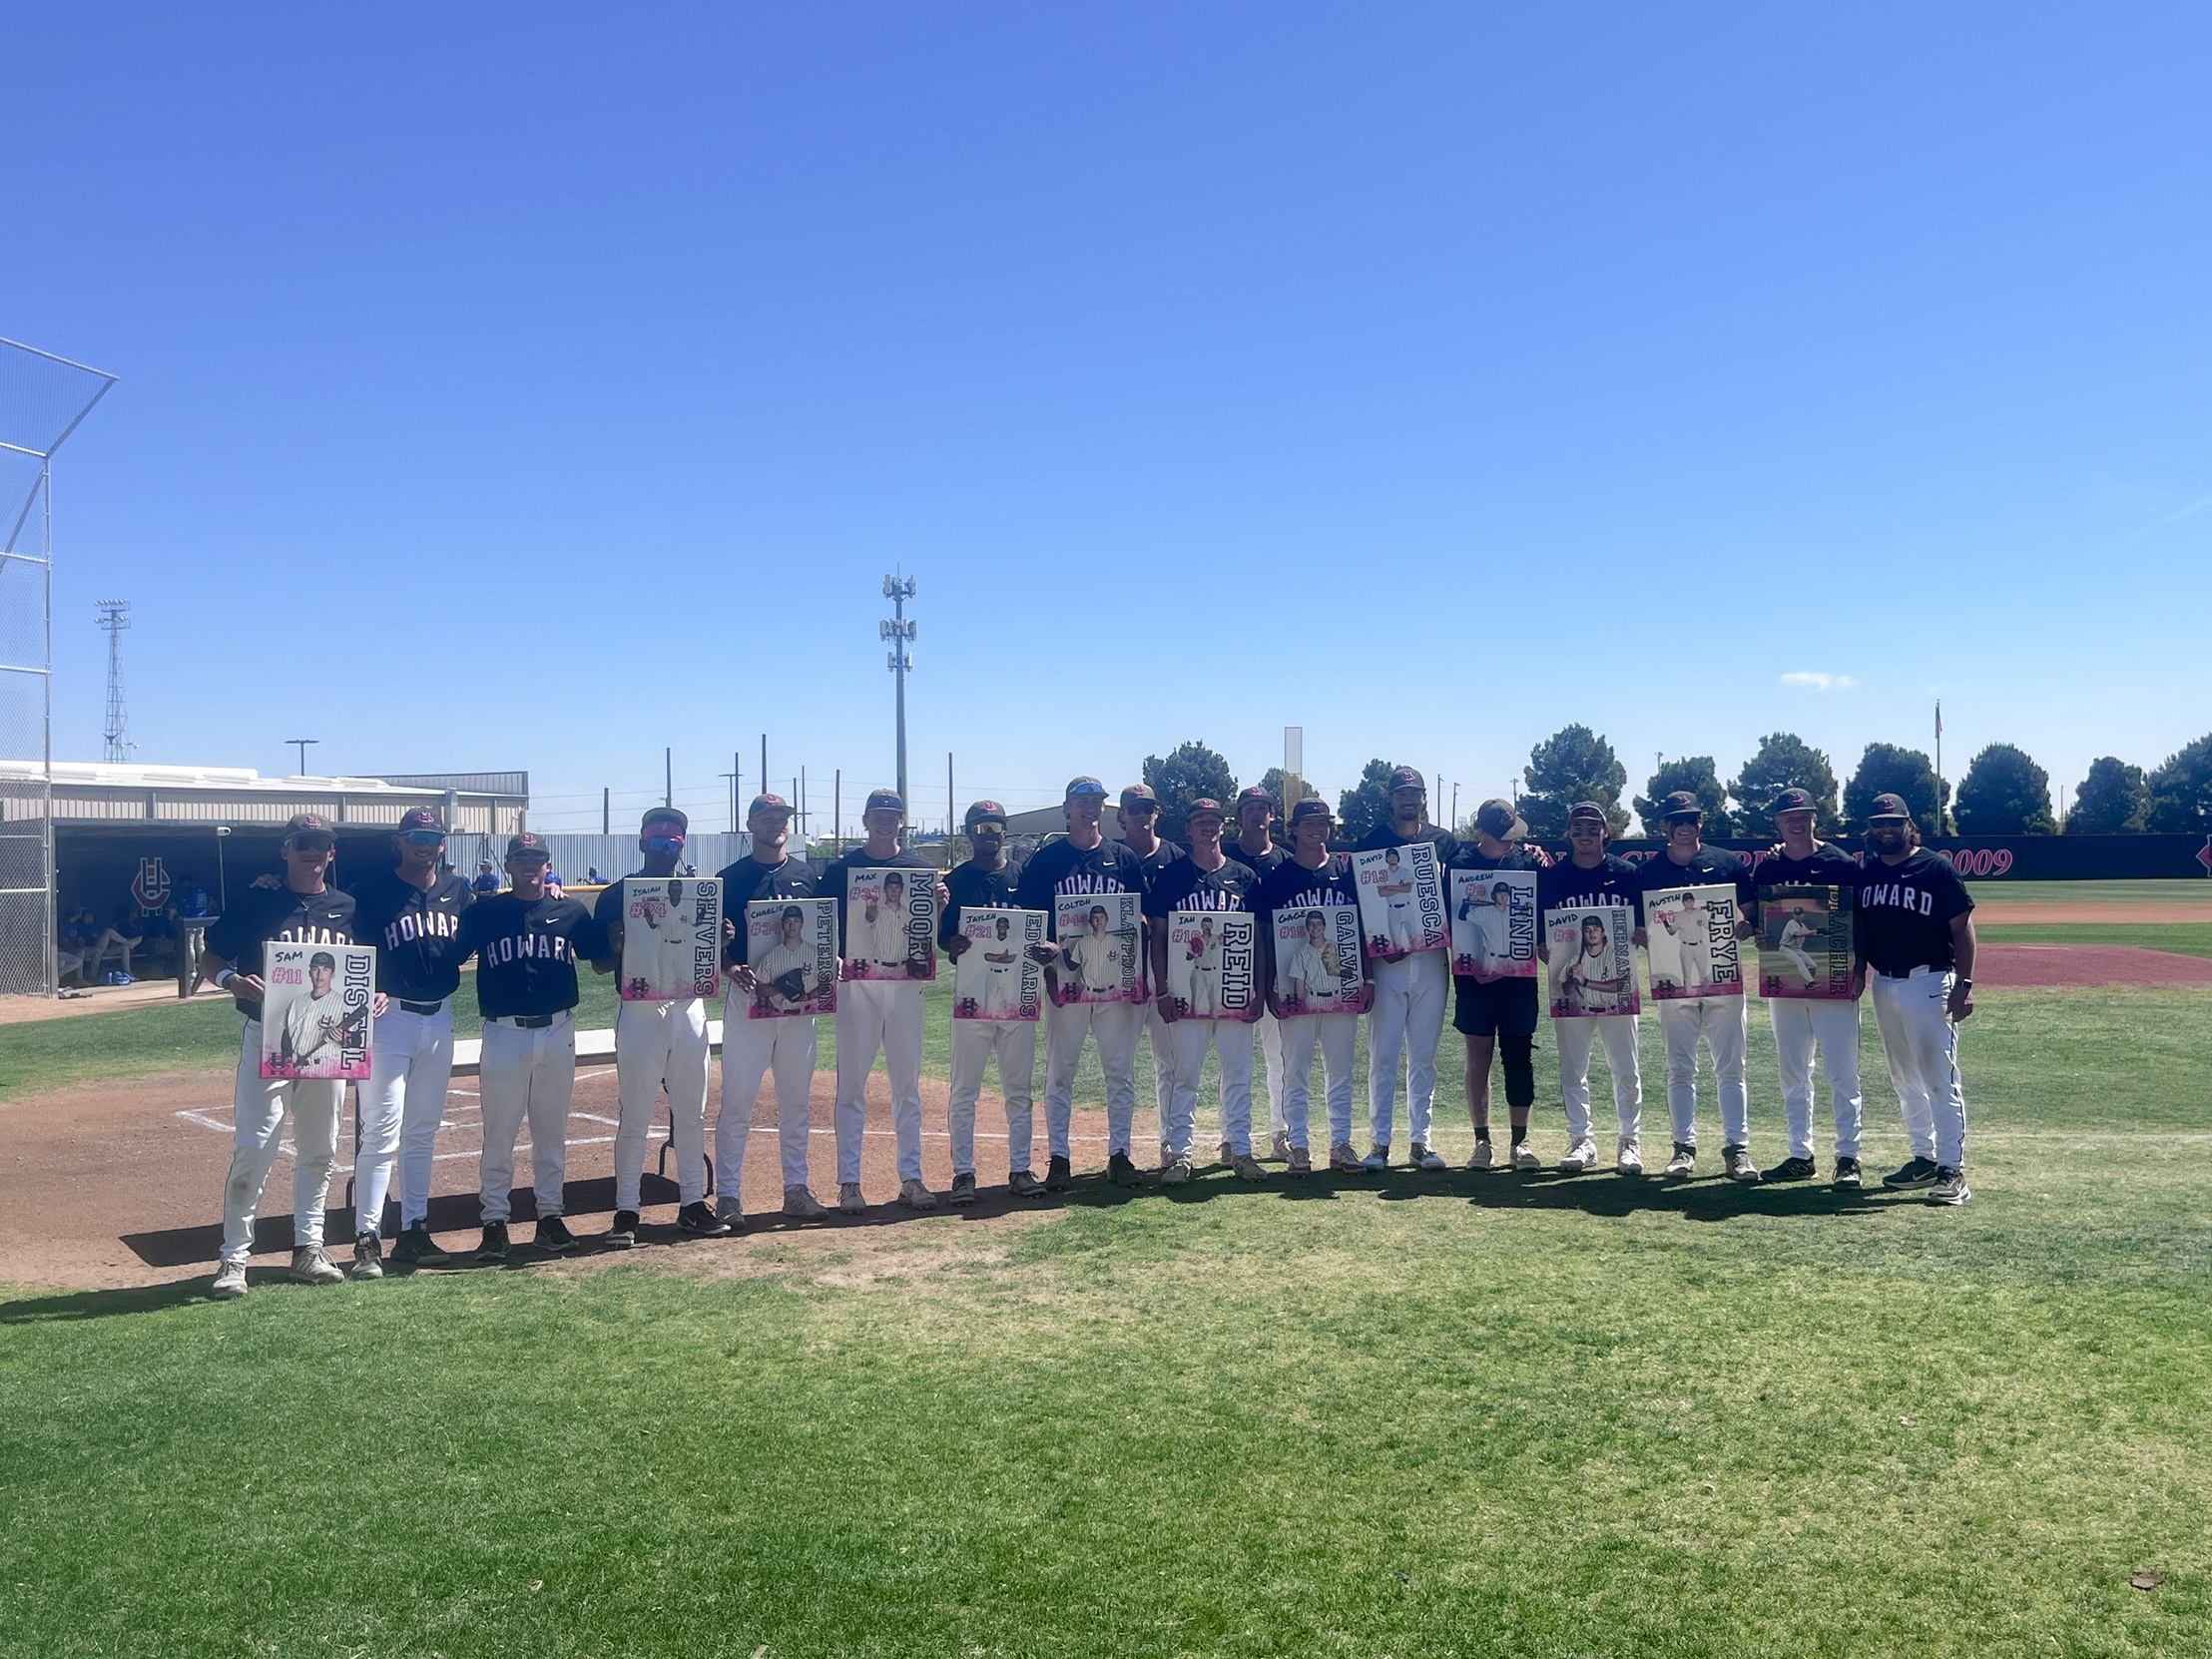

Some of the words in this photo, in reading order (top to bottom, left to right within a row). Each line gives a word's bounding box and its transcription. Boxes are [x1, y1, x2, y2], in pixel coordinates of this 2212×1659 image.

[1360, 853, 1383, 865] DAVID
[854, 873, 877, 883] MAX
[1360, 869, 1388, 884] #13
[1457, 873, 1493, 884] ANDREW
[1410, 845, 1444, 947] RUESCA
[1648, 893, 1681, 908] AUSTIN
[1861, 883, 1933, 916] OWARD
[750, 904, 785, 919] CHARLIE
[1058, 898, 1091, 911] COLTON
[965, 913, 997, 924] JAYLEN
[1178, 916, 1196, 925] IAN
[1278, 910, 1307, 924] GAGE
[1509, 885, 1533, 961] LIND
[1547, 914, 1578, 928] DAVID
[383, 911, 458, 951] HOWAR
[694, 881, 718, 996] SHIVERS
[964, 924, 992, 938] #21
[1120, 896, 1137, 997] KLAPPRODT
[1706, 898, 1740, 984] FRYE
[275, 951, 303, 963] SAM
[486, 933, 573, 968] HOWAR
[817, 901, 833, 1012] PETERSON
[1336, 910, 1360, 1003] GALVAN
[1221, 922, 1253, 1010] REID
[1611, 909, 1633, 1015] HERNANDEZ
[272, 967, 303, 985] #11
